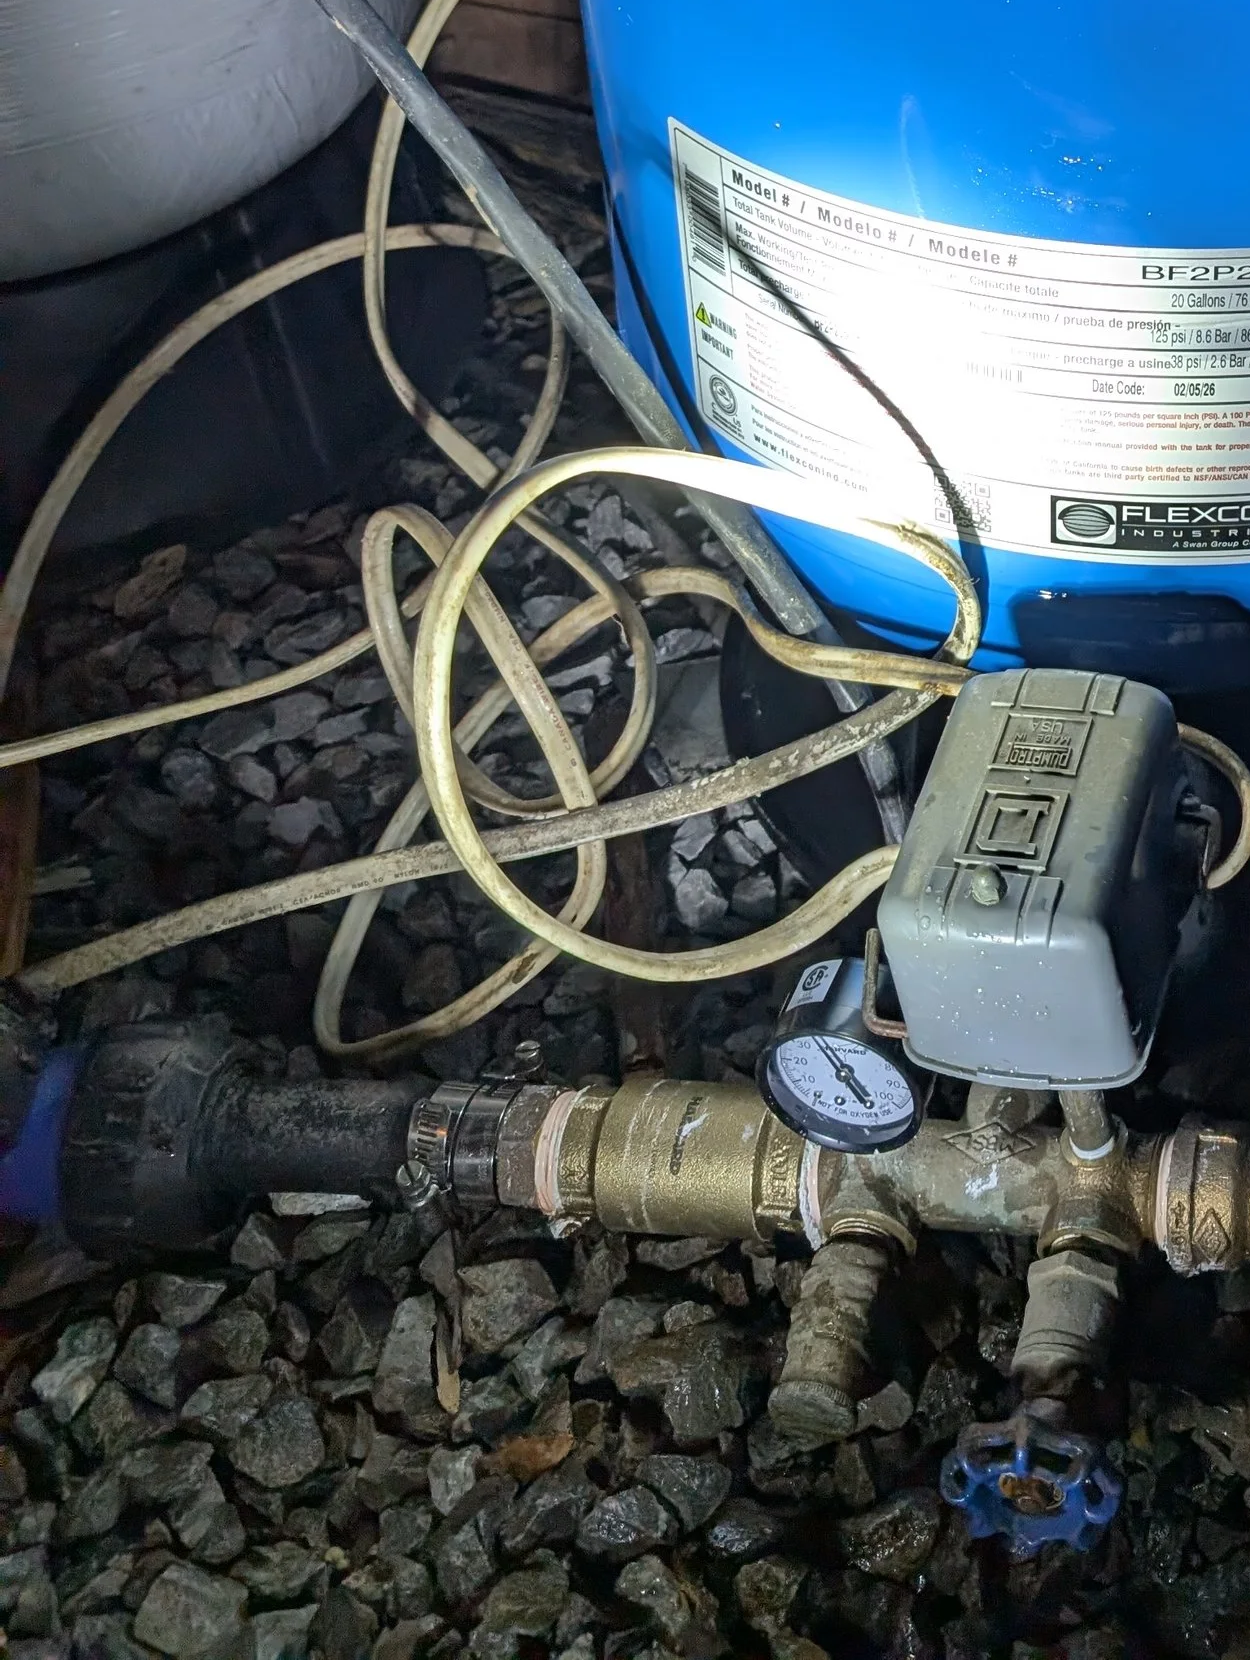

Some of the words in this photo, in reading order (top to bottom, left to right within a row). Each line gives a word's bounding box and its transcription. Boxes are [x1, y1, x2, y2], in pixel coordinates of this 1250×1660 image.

[732, 169, 777, 203] Model
[781, 193, 790, 208] #
[817, 206, 882, 239] Modelo
[888, 230, 897, 243] #
[929, 238, 1001, 265] Modele
[1007, 254, 1018, 267] #
[733, 196, 754, 215] Total
[756, 203, 776, 226] Tank
[778, 219, 812, 241] Volume
[1171, 294, 1185, 307] 20
[1187, 293, 1226, 308] Gallons
[1235, 293, 1248, 306] 76
[710, 312, 738, 339] WARNING
[1063, 315, 1105, 330] prueba
[1109, 317, 1123, 329] de
[701, 329, 734, 360] IMPORTANT
[1151, 330, 1169, 344] 125
[1171, 331, 1186, 347] psi
[1196, 330, 1212, 344] 8.6
[1214, 329, 1233, 343] Bar
[1063, 353, 1124, 369] precharge
[1127, 359, 1135, 369] a
[1138, 357, 1170, 370] usine
[1170, 355, 1183, 369] 38
[1186, 356, 1201, 371] psi
[1210, 354, 1227, 368] 2.6
[1229, 353, 1247, 367] Bar
[1092, 379, 1114, 393] Date
[1116, 380, 1145, 395] Code:
[1173, 383, 1215, 396] 02/05/26
[1161, 443, 1177, 451] with
[1181, 443, 1192, 451] the
[1183, 540, 1207, 548] Swan
[1210, 538, 1239, 549] Group
[1031, 719, 1064, 734] USA
[1015, 733, 1027, 743] IN
[1036, 734, 1071, 746] MADE
[1005, 742, 1072, 769] PUMPTROL
[798, 1041, 811, 1049] 30
[794, 1056, 808, 1066] 20
[802, 1075, 815, 1083] 10
[886, 1079, 900, 1088] 90
[874, 1091, 894, 1100] 100
[818, 1100, 832, 1109] NOT
[834, 1105, 848, 1115] FOR
